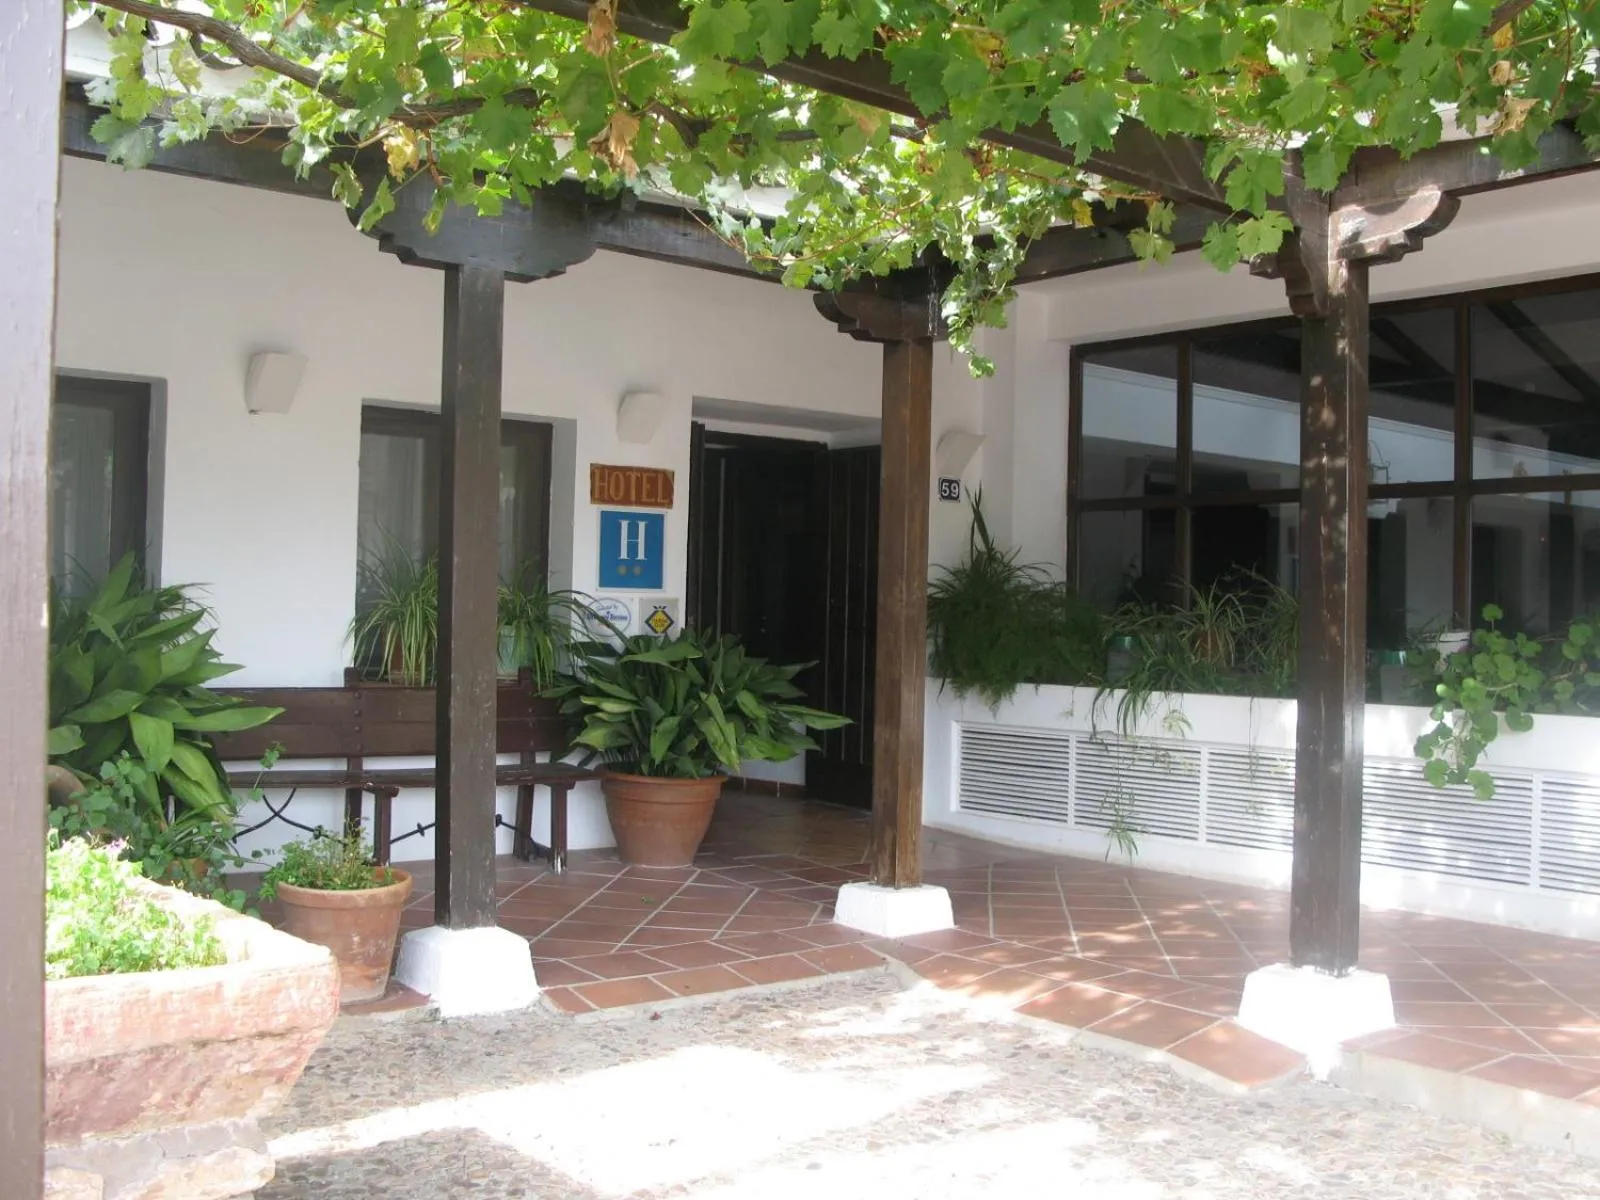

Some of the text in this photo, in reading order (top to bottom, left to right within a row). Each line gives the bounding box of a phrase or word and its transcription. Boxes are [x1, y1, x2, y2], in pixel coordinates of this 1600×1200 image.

[594, 468, 670, 504] HOTEL
[941, 482, 959, 498] 59
[618, 519, 648, 560] H
